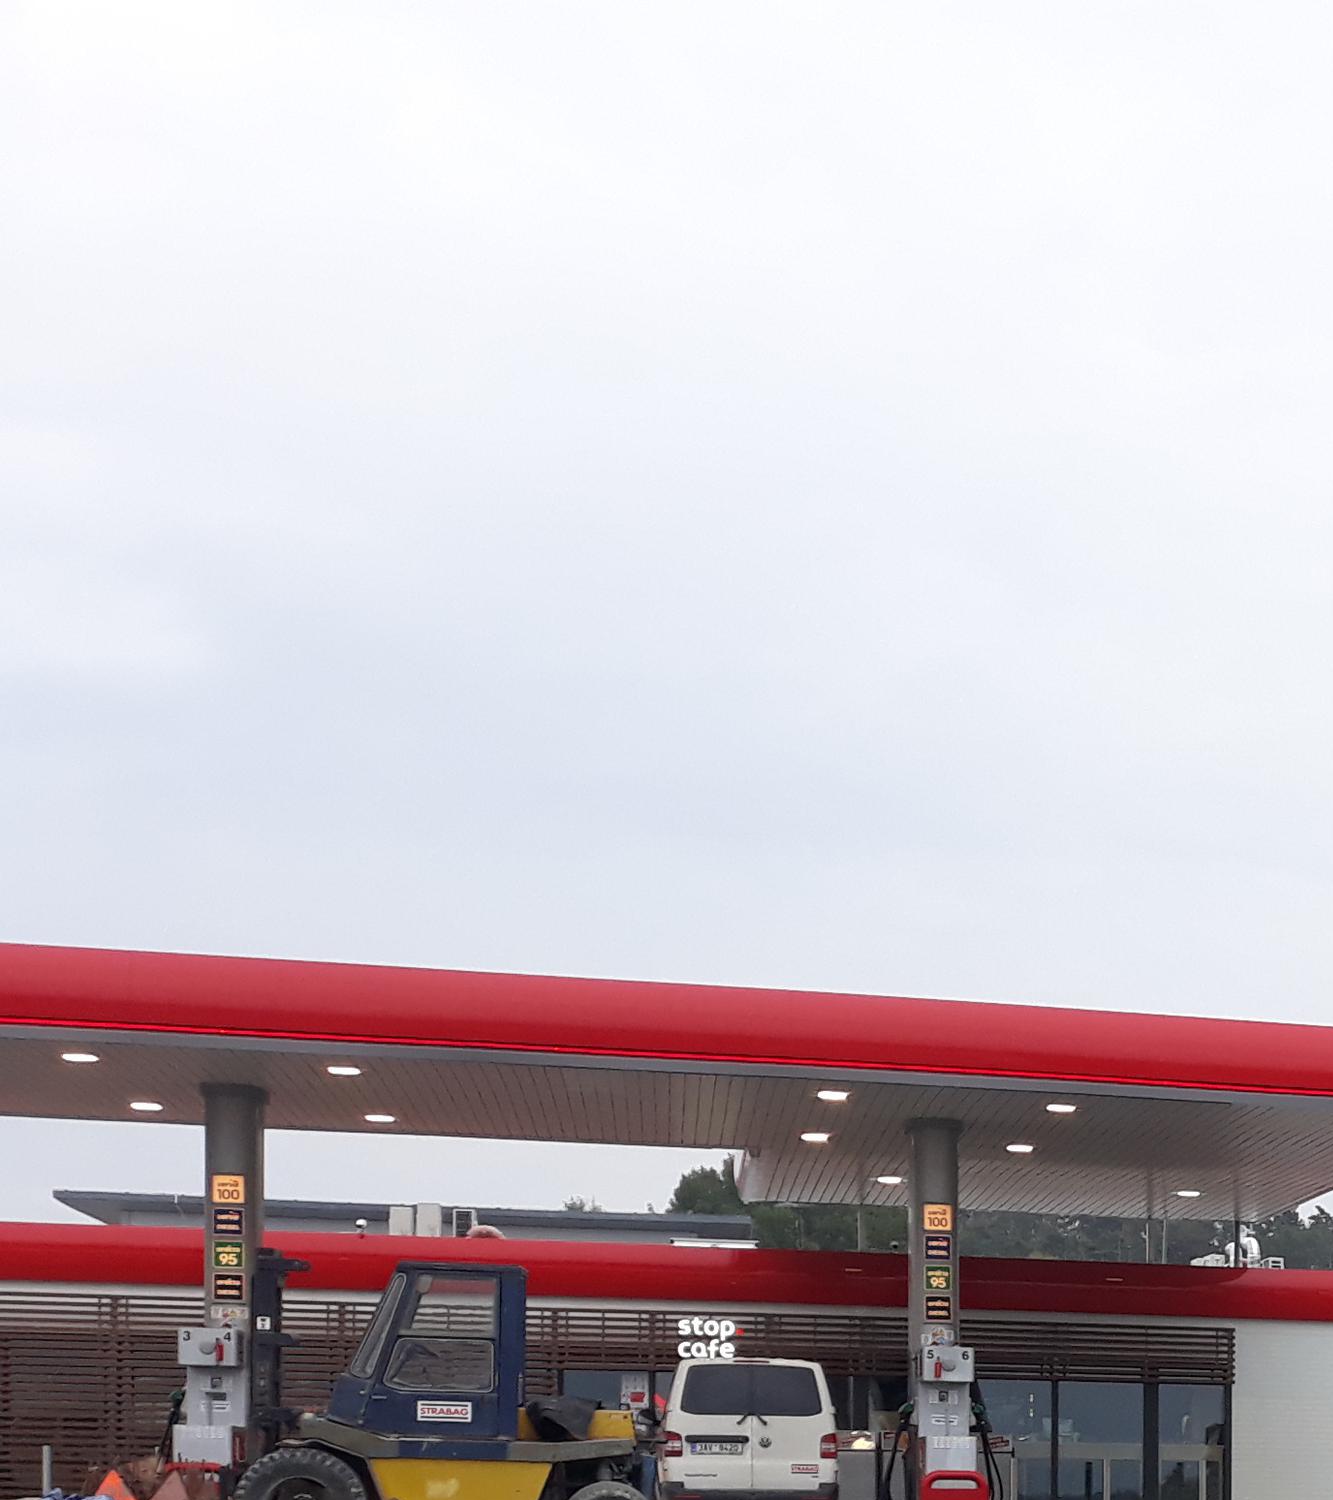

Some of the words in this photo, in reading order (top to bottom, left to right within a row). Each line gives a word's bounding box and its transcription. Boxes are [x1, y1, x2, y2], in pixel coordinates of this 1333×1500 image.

[217, 1189, 239, 1200] 100
[927, 1216, 948, 1228] 100
[219, 1253, 238, 1266] 95
[930, 1276, 947, 1289] 95
[183, 1330, 191, 1342] 3
[223, 1331, 231, 1342] 4
[677, 1339, 736, 1359] cafe
[926, 1350, 934, 1359] 5
[962, 1351, 970, 1361] 6
[420, 1407, 469, 1416] STRABAG
